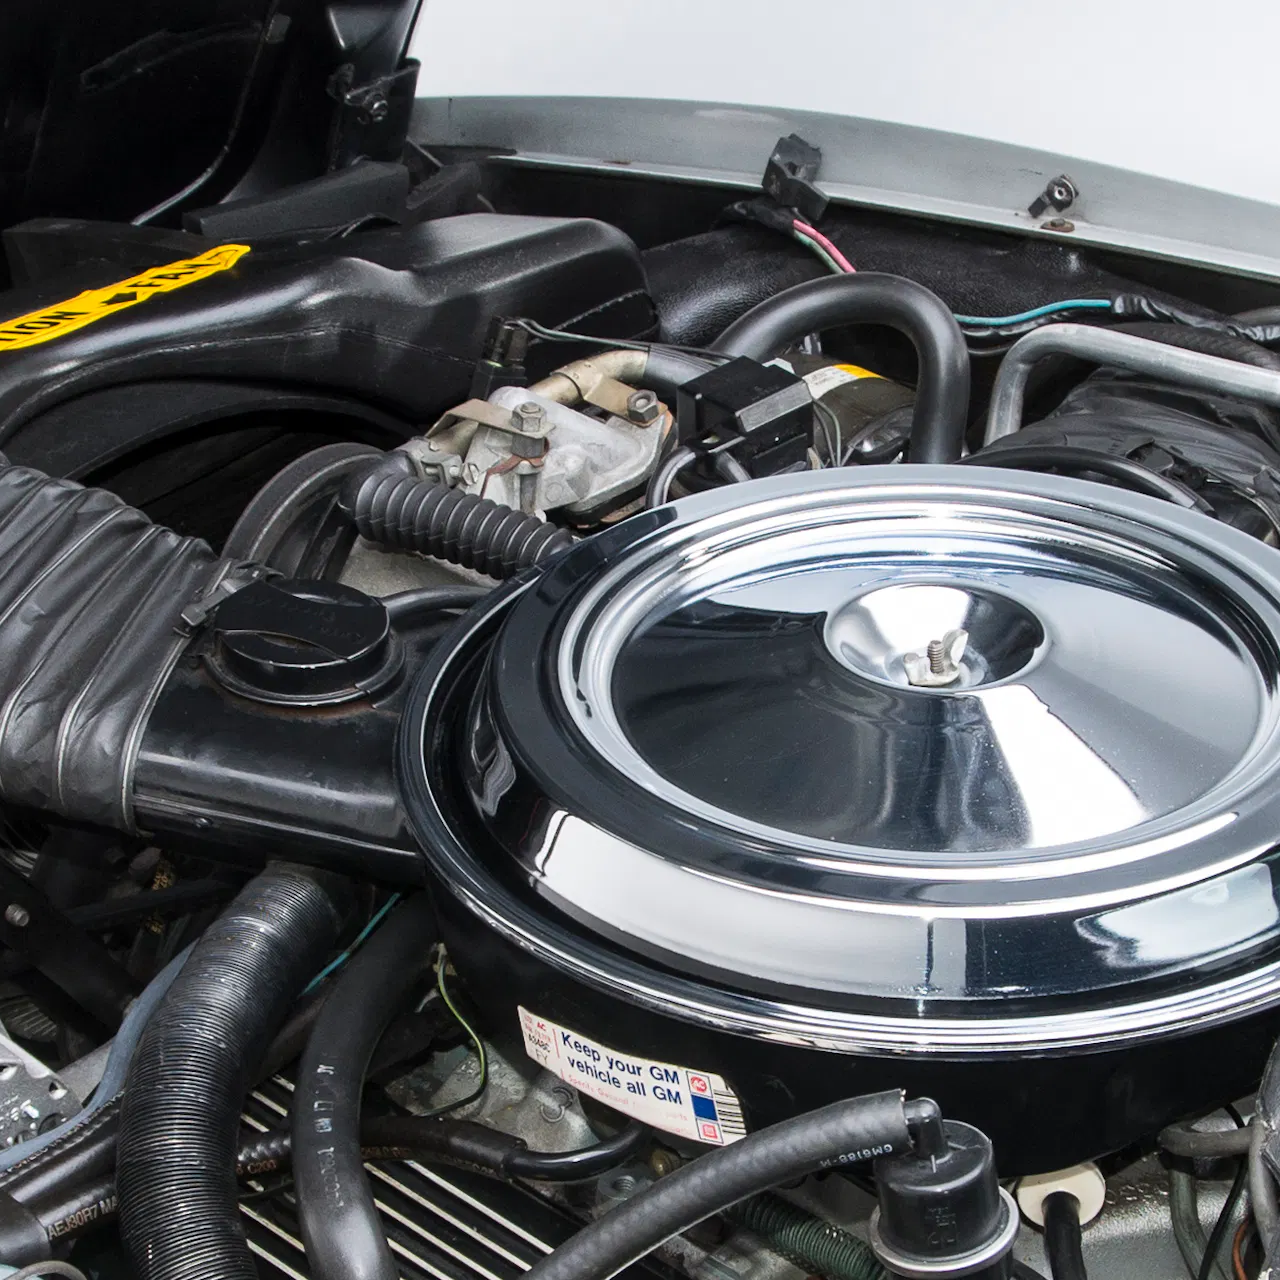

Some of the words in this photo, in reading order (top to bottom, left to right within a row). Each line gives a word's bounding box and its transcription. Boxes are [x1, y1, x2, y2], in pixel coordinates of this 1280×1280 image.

[561, 1031, 602, 1062] Keep
[605, 1053, 643, 1077] your
[649, 1065, 681, 1086] GM
[566, 1055, 621, 1089] vehicle
[626, 1080, 647, 1097] all
[652, 1085, 683, 1106] GM
